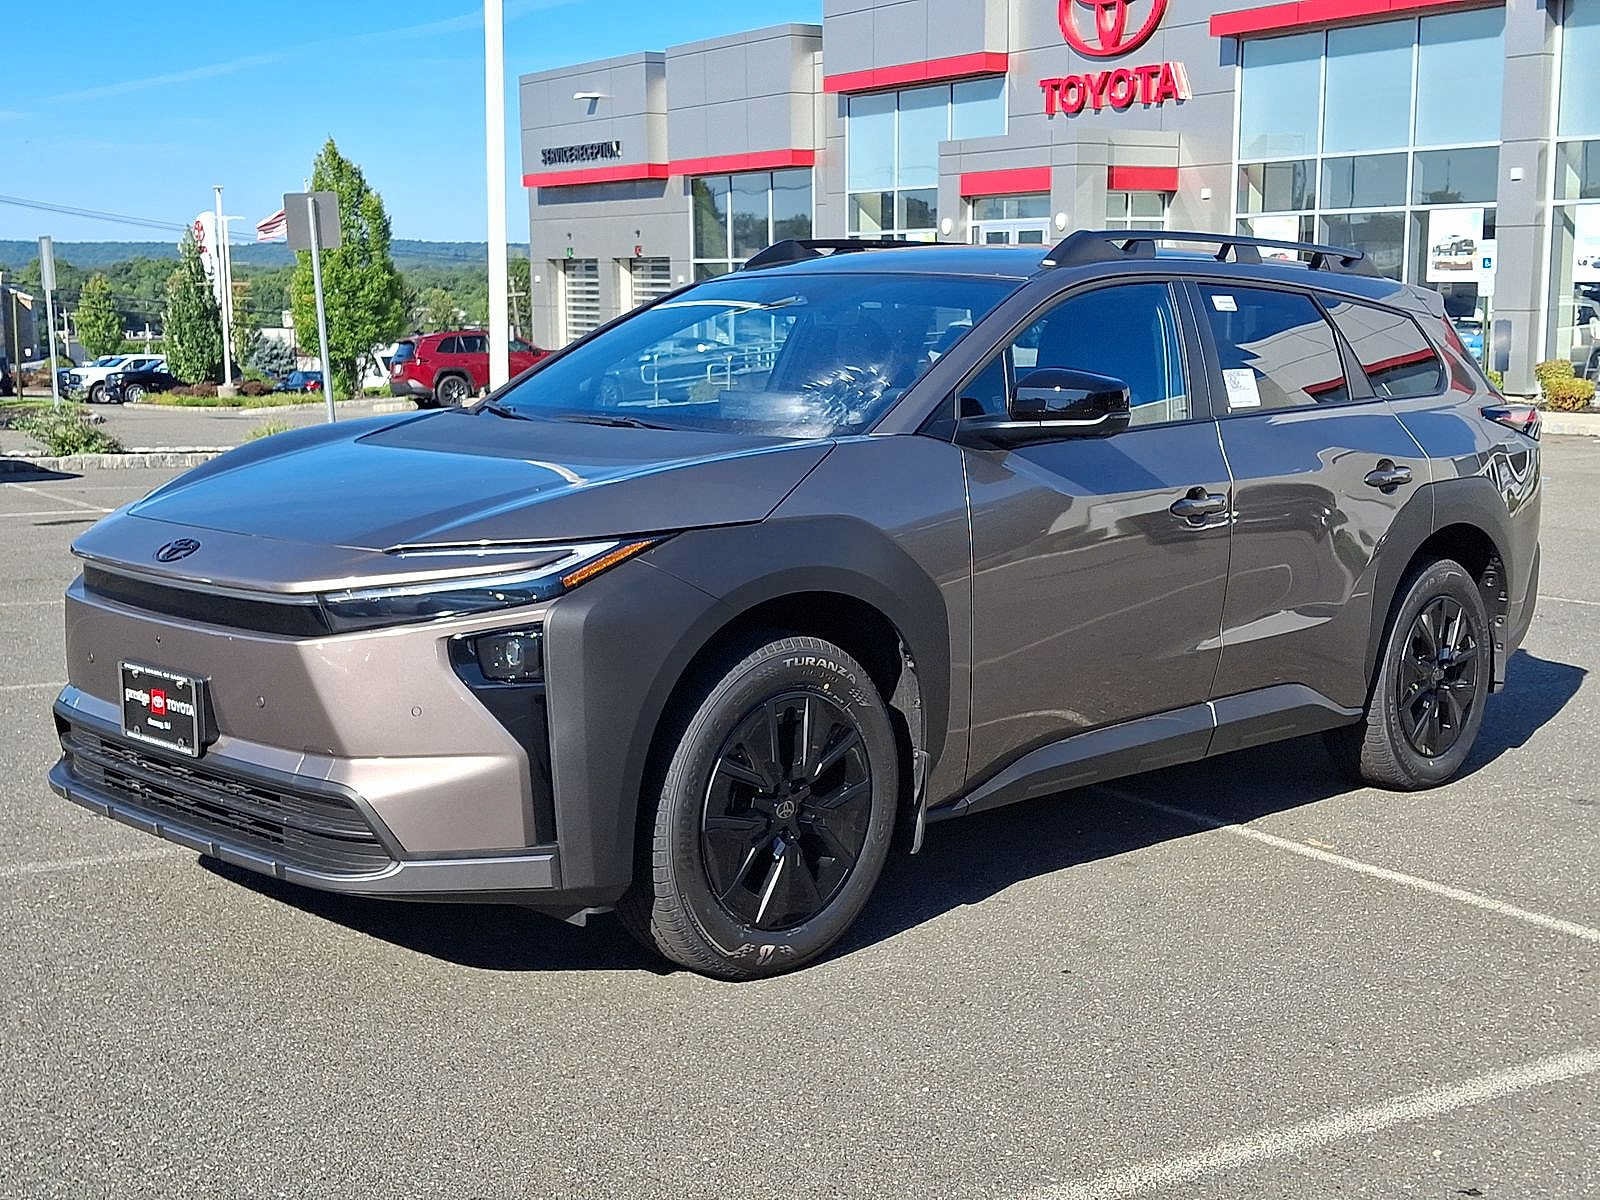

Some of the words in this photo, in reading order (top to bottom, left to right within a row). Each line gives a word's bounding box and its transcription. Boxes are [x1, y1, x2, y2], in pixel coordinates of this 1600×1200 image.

[1040, 62, 1191, 114] TOYOTA
[541, 147, 577, 165] SERVICE
[783, 656, 856, 685] TURANZA
[166, 698, 194, 716] TOYOTA
